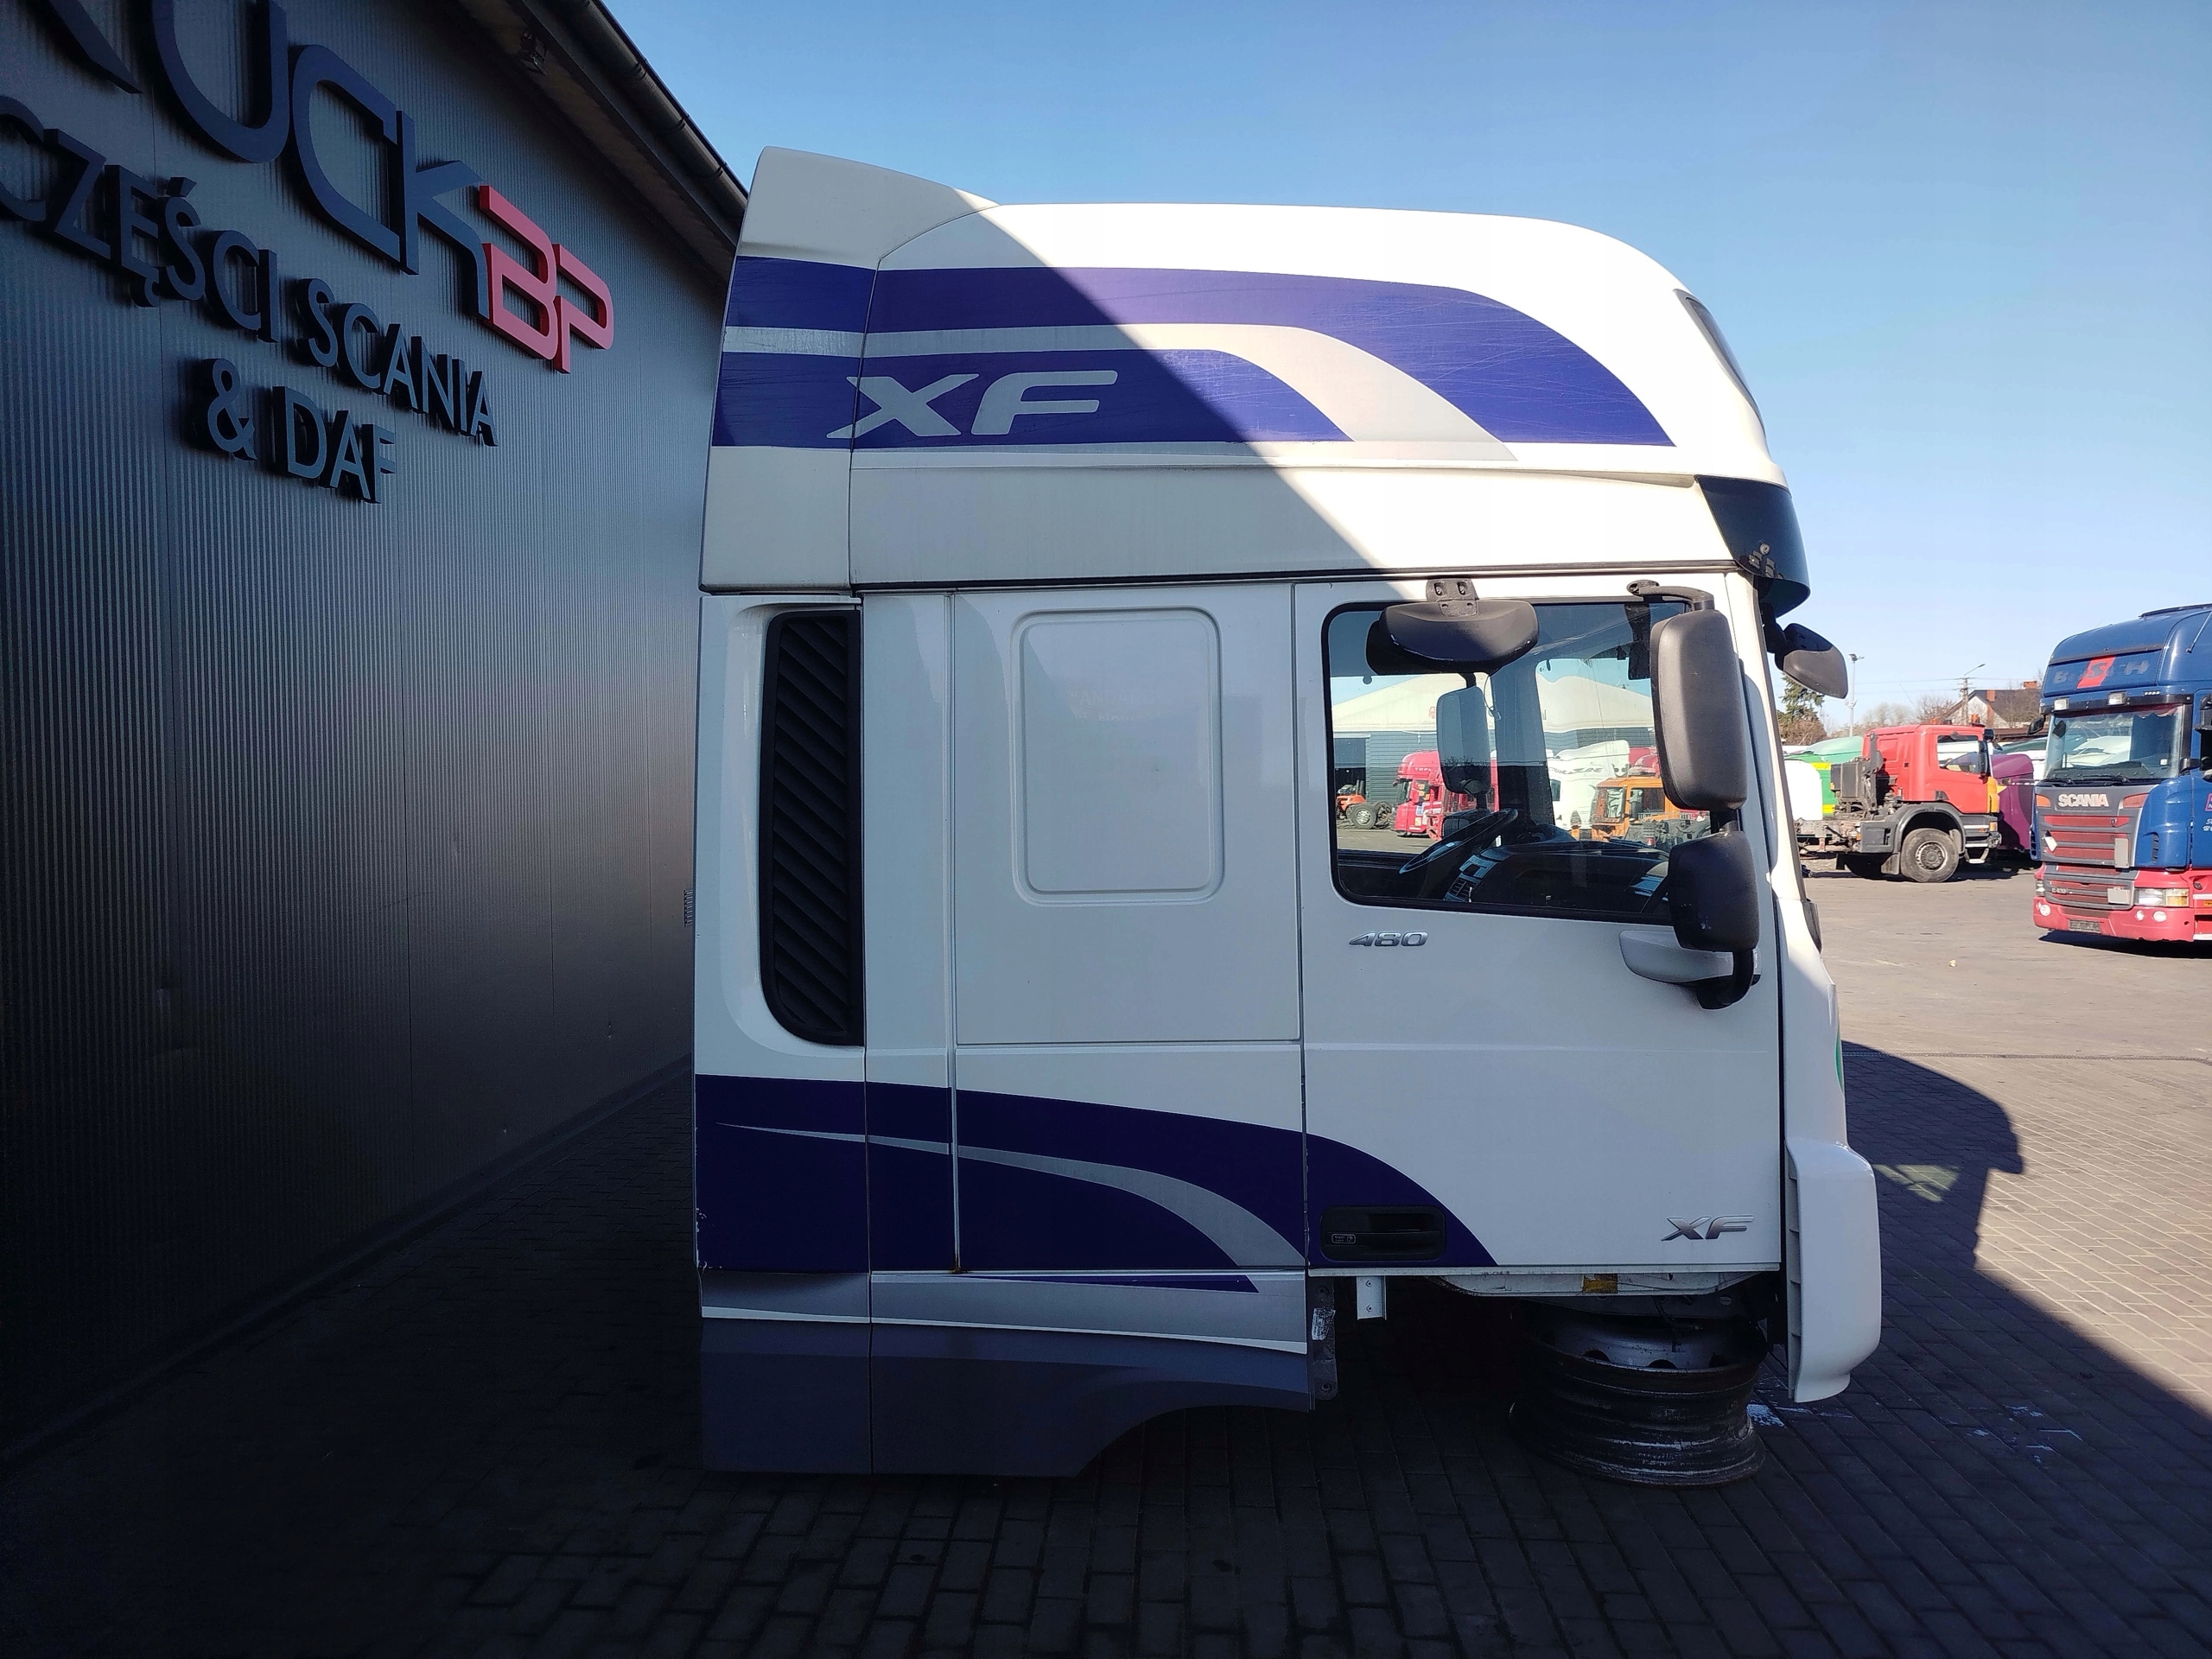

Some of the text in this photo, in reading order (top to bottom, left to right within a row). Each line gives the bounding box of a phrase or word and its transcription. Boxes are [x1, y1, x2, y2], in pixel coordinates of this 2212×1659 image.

[302, 278, 499, 447] SCANIA
[826, 370, 1119, 439] XF
[206, 359, 396, 504] & DAF
[2057, 793, 2109, 807] SCANIA
[1349, 931, 1428, 947] 480
[1660, 1214, 1755, 1242] XF
